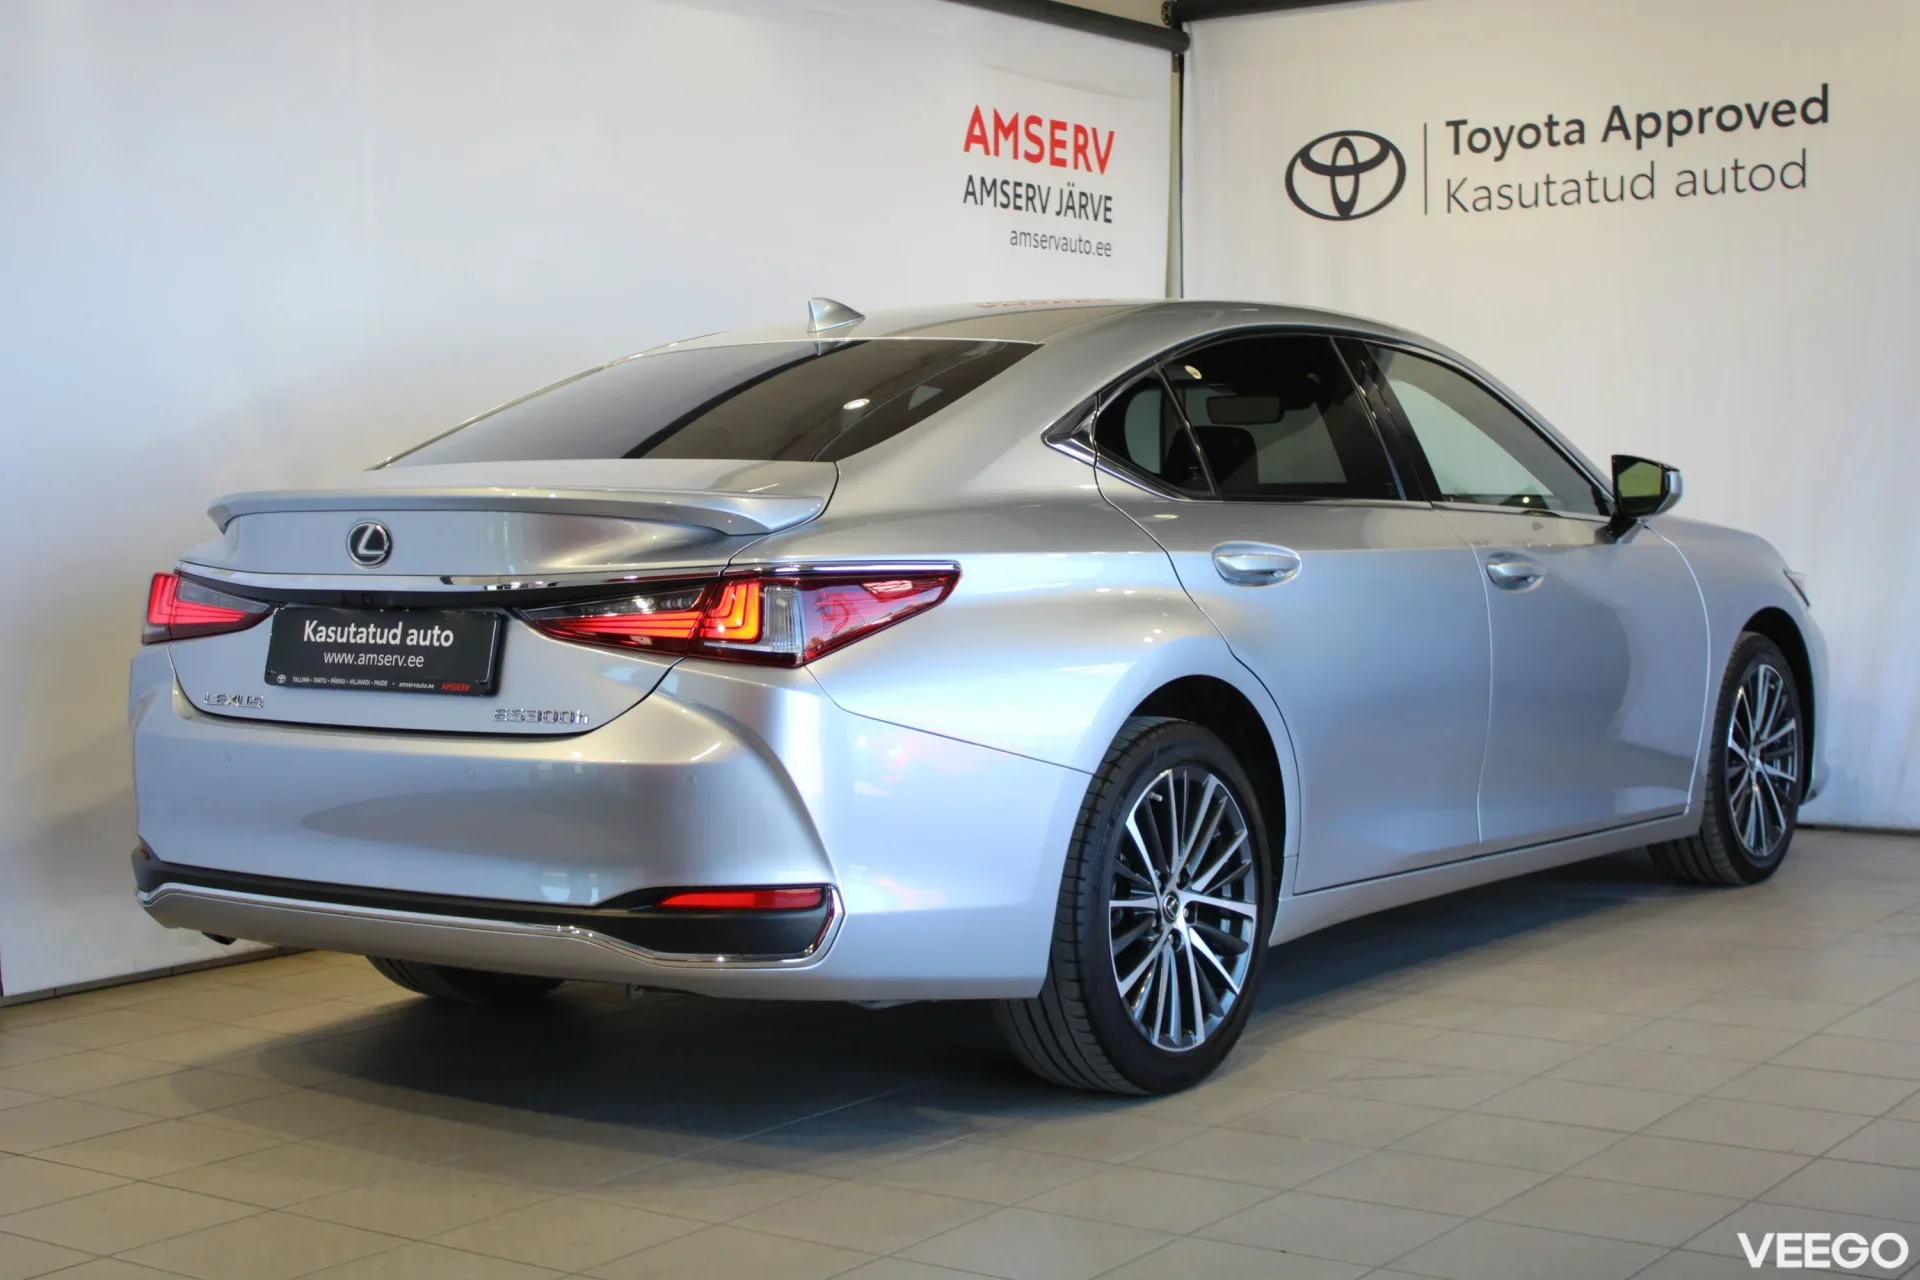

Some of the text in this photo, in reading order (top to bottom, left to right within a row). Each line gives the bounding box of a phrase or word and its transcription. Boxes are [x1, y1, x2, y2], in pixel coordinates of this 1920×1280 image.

[1445, 82, 1829, 163] Toyota Approved
[963, 104, 1115, 175] AMSERV
[1446, 148, 1808, 214] Kasutatud autod
[963, 174, 1113, 224] AMSERV JÄRVE
[1009, 229, 1112, 258] amservauto.ee
[303, 619, 454, 647] Kasutatud auto
[323, 650, 425, 668] www.amserv.ee
[203, 691, 265, 708] LEXUS
[398, 681, 435, 690] amservauto.ee
[440, 682, 471, 692] AMSERV
[493, 708, 590, 725] ES300h
